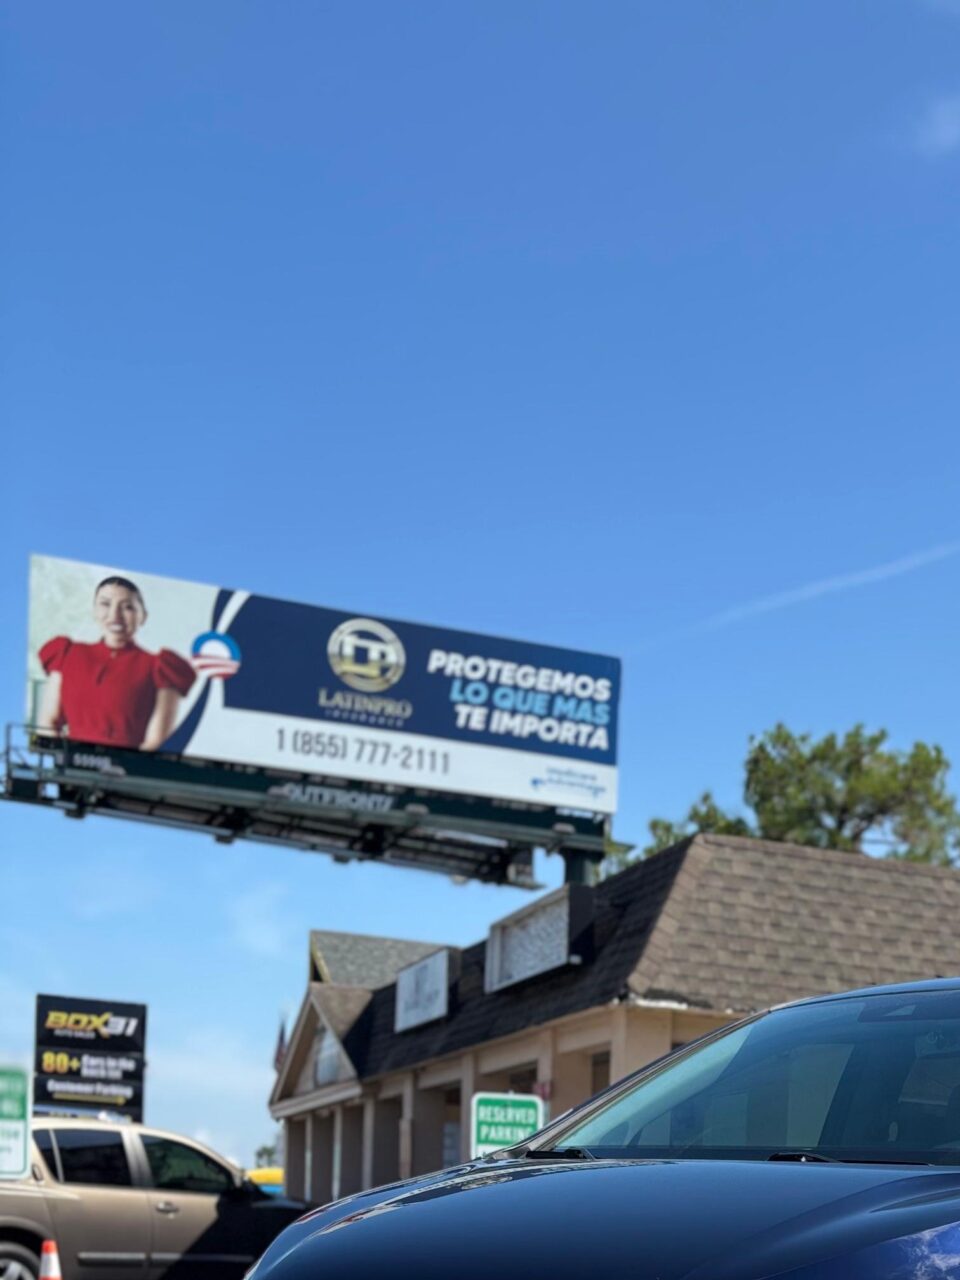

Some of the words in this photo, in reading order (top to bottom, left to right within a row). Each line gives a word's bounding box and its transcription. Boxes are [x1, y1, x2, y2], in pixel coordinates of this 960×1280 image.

[427, 649, 612, 702] PROTEGEMOS
[450, 680, 489, 705] LO
[492, 686, 549, 716] QUE
[553, 695, 611, 726] MAS
[454, 703, 487, 731] TE
[490, 708, 609, 751] IMPORTA
[276, 727, 285, 752] 1
[292, 730, 348, 760] (855)
[354, 738, 450, 775] 777-2111
[478, 1105, 537, 1125] RESERVED
